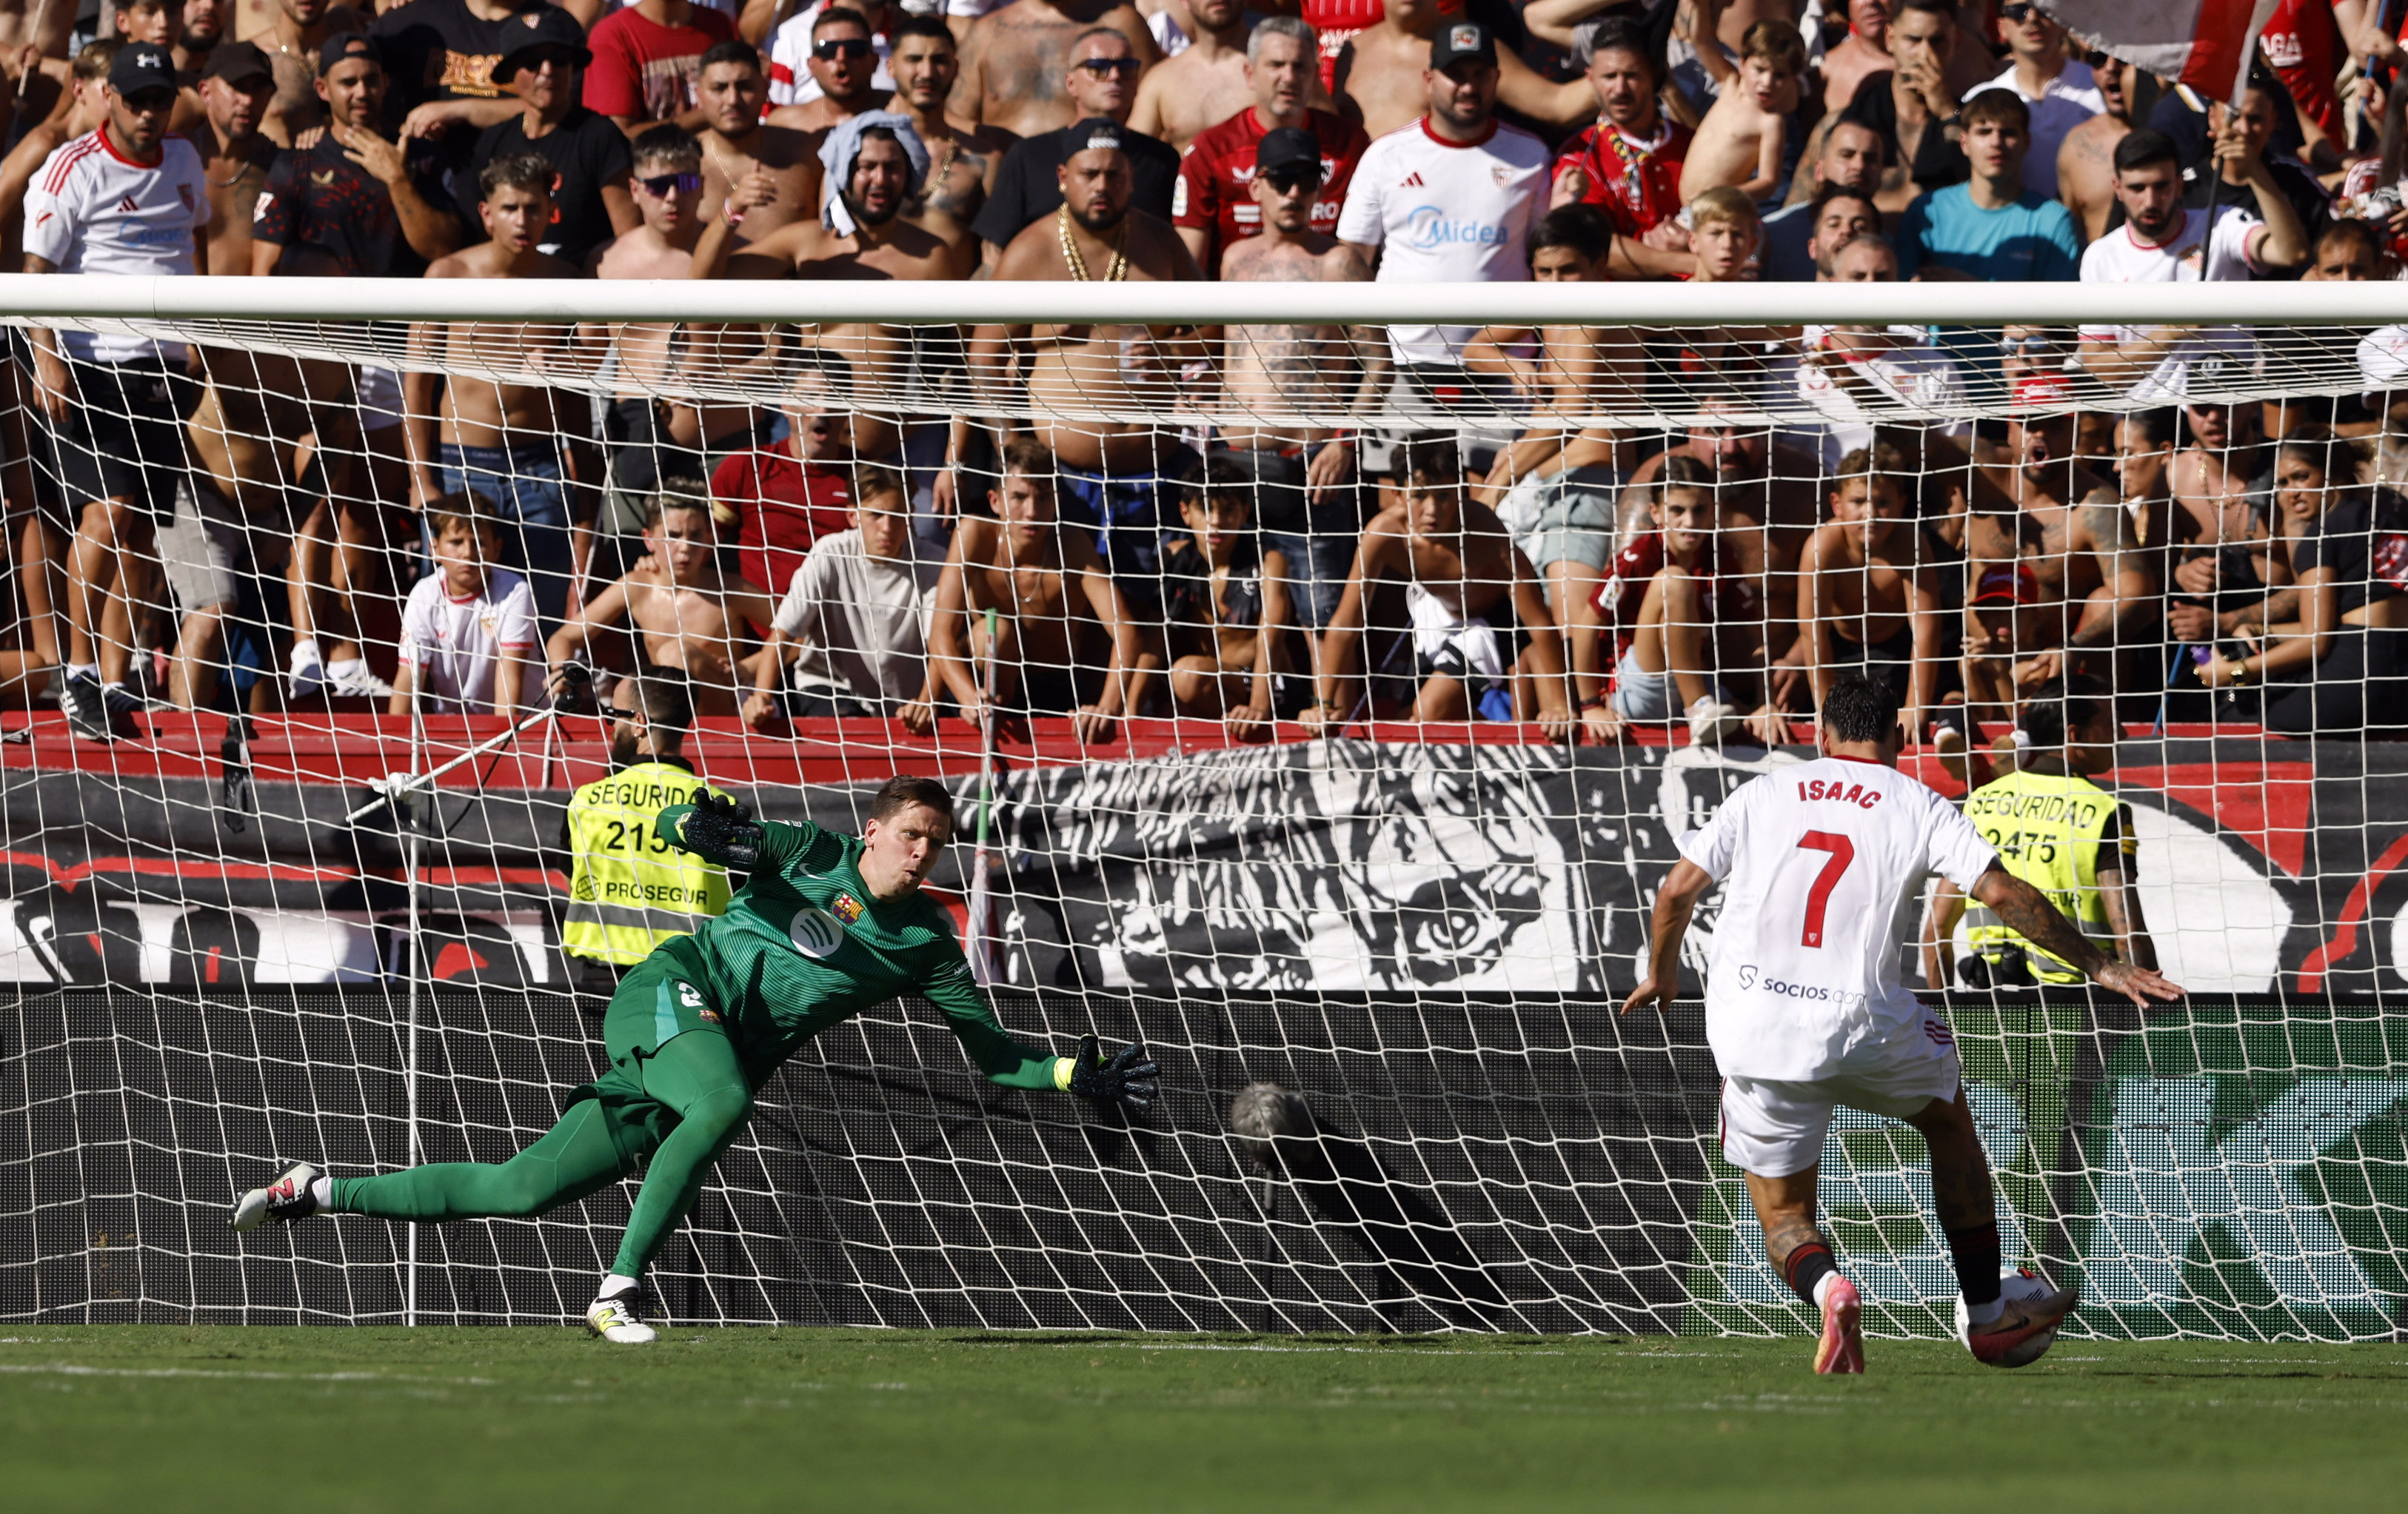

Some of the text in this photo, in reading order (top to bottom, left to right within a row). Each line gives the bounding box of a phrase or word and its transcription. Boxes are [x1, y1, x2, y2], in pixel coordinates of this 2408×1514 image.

[1408, 206, 1508, 248] Midea
[589, 783, 698, 808] SEGURIDA
[1798, 780, 1882, 808] ISAAC
[1973, 790, 2096, 828] SEGURIDAD
[606, 821, 688, 854] 215
[1986, 828, 2057, 864] 2475
[606, 882, 707, 905] PROSEGUR
[1796, 829, 1855, 948] 7
